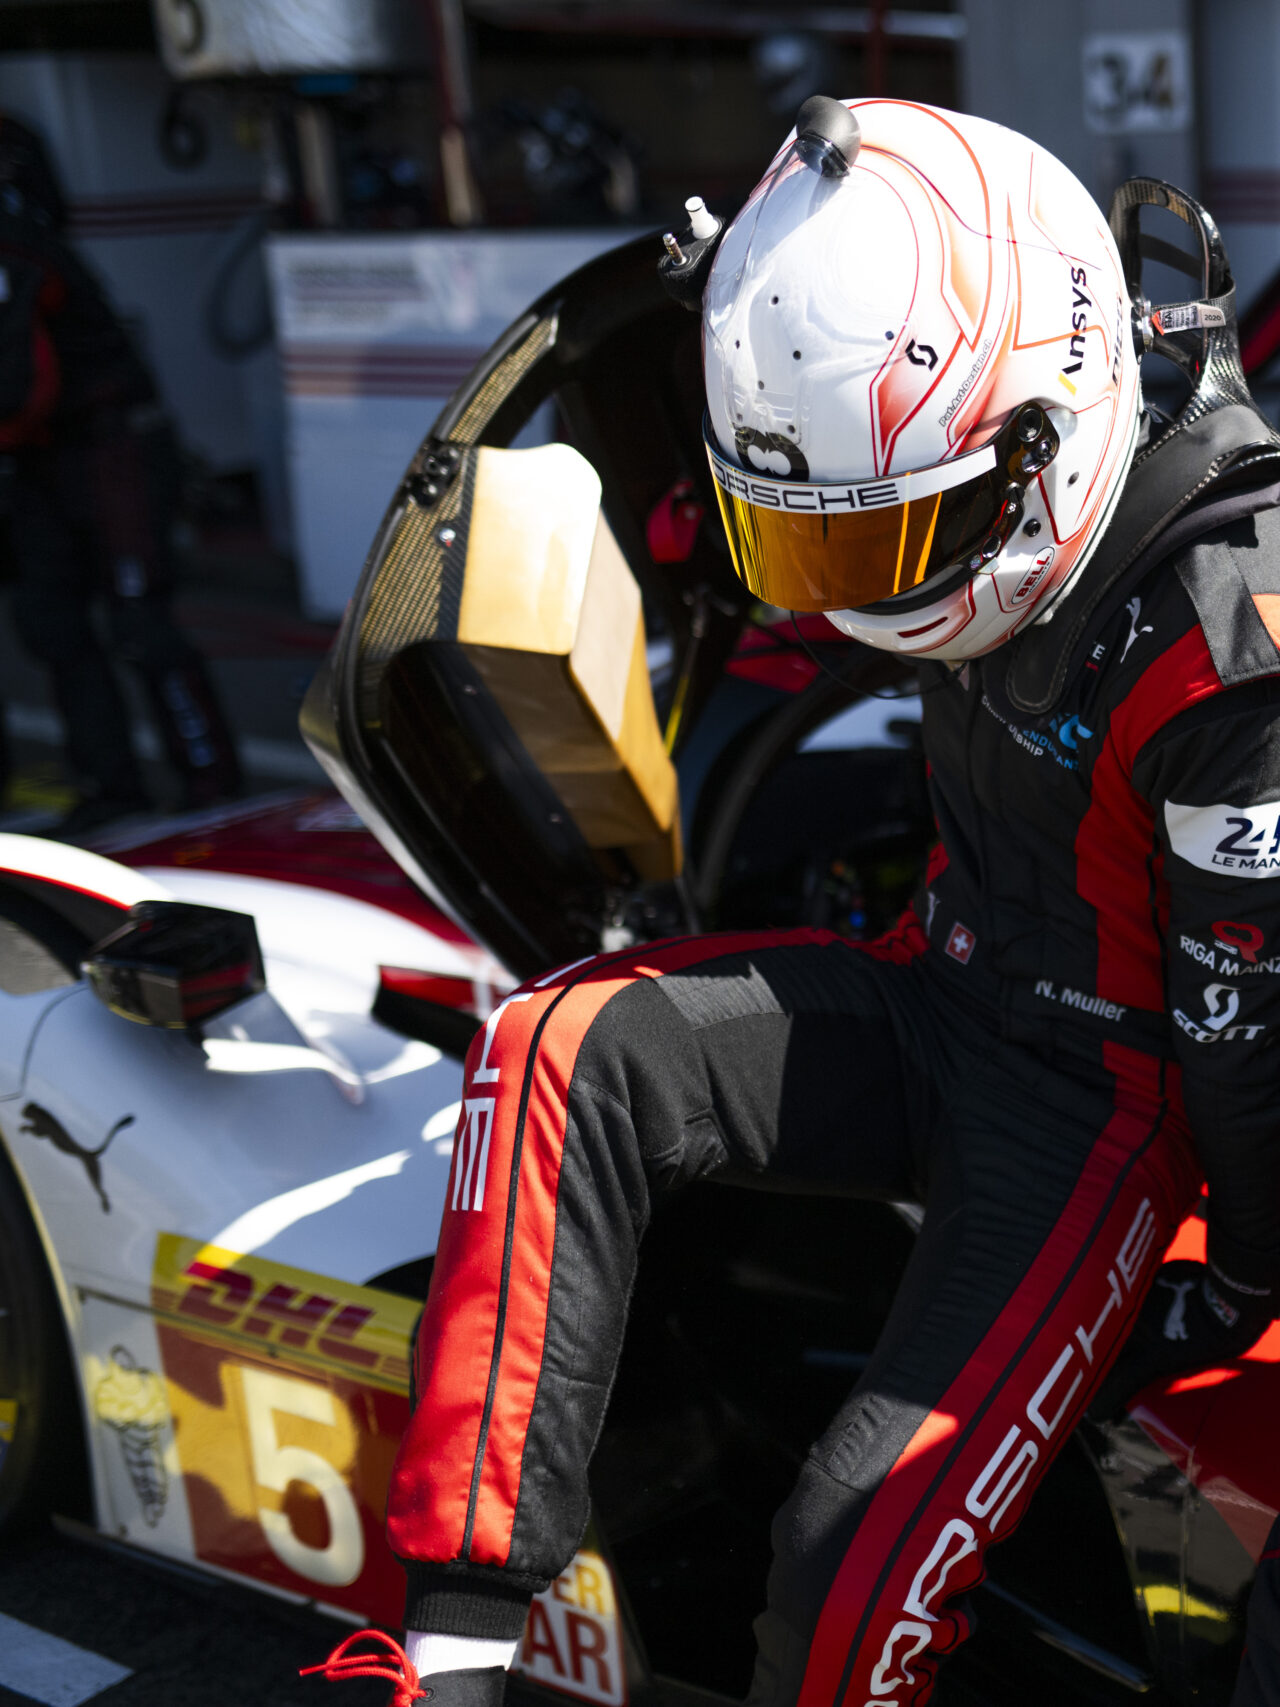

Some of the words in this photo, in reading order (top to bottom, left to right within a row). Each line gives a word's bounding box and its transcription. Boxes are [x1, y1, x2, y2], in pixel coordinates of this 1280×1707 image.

[1086, 53, 1174, 123] 34
[1058, 267, 1092, 397] Ansys
[1016, 556, 1051, 598] BELL
[1211, 853, 1236, 867] LE
[1180, 935, 1216, 970] RIGA
[1035, 980, 1057, 1000] N.
[1061, 987, 1127, 1022] Muller
[1172, 1008, 1266, 1043] SCOTT
[178, 1261, 376, 1368] DHL
[241, 1365, 366, 1588] 5
[864, 1198, 1158, 1707] ORSCHE
